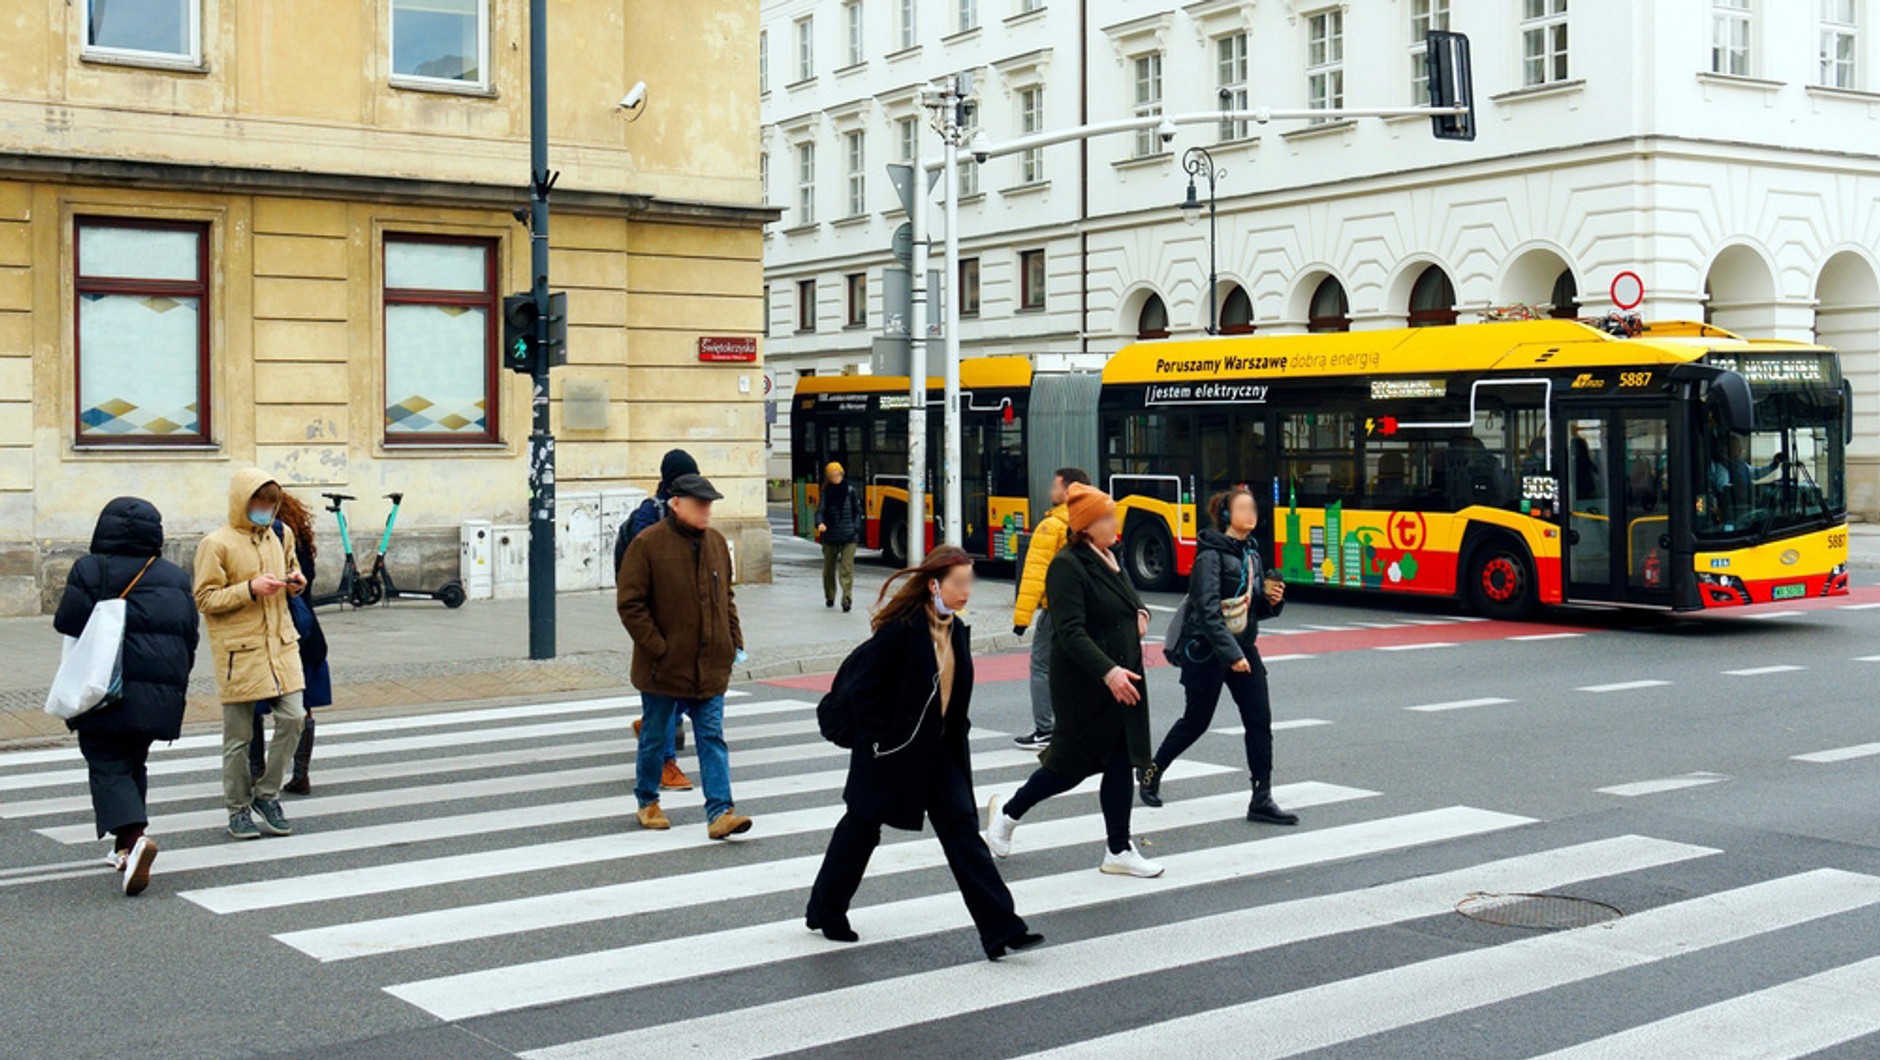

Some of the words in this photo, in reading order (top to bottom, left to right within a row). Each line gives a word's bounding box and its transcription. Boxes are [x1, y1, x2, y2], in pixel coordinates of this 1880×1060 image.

[1155, 357, 1221, 374] Poruszamy
[1224, 355, 1288, 372] Warszawę
[1290, 354, 1326, 371] dobrą
[1331, 351, 1380, 369] energią
[1618, 371, 1653, 387] 5887
[1150, 385, 1192, 402] jestem
[1195, 383, 1269, 400] elektryczny
[1827, 534, 1847, 549] 5887
